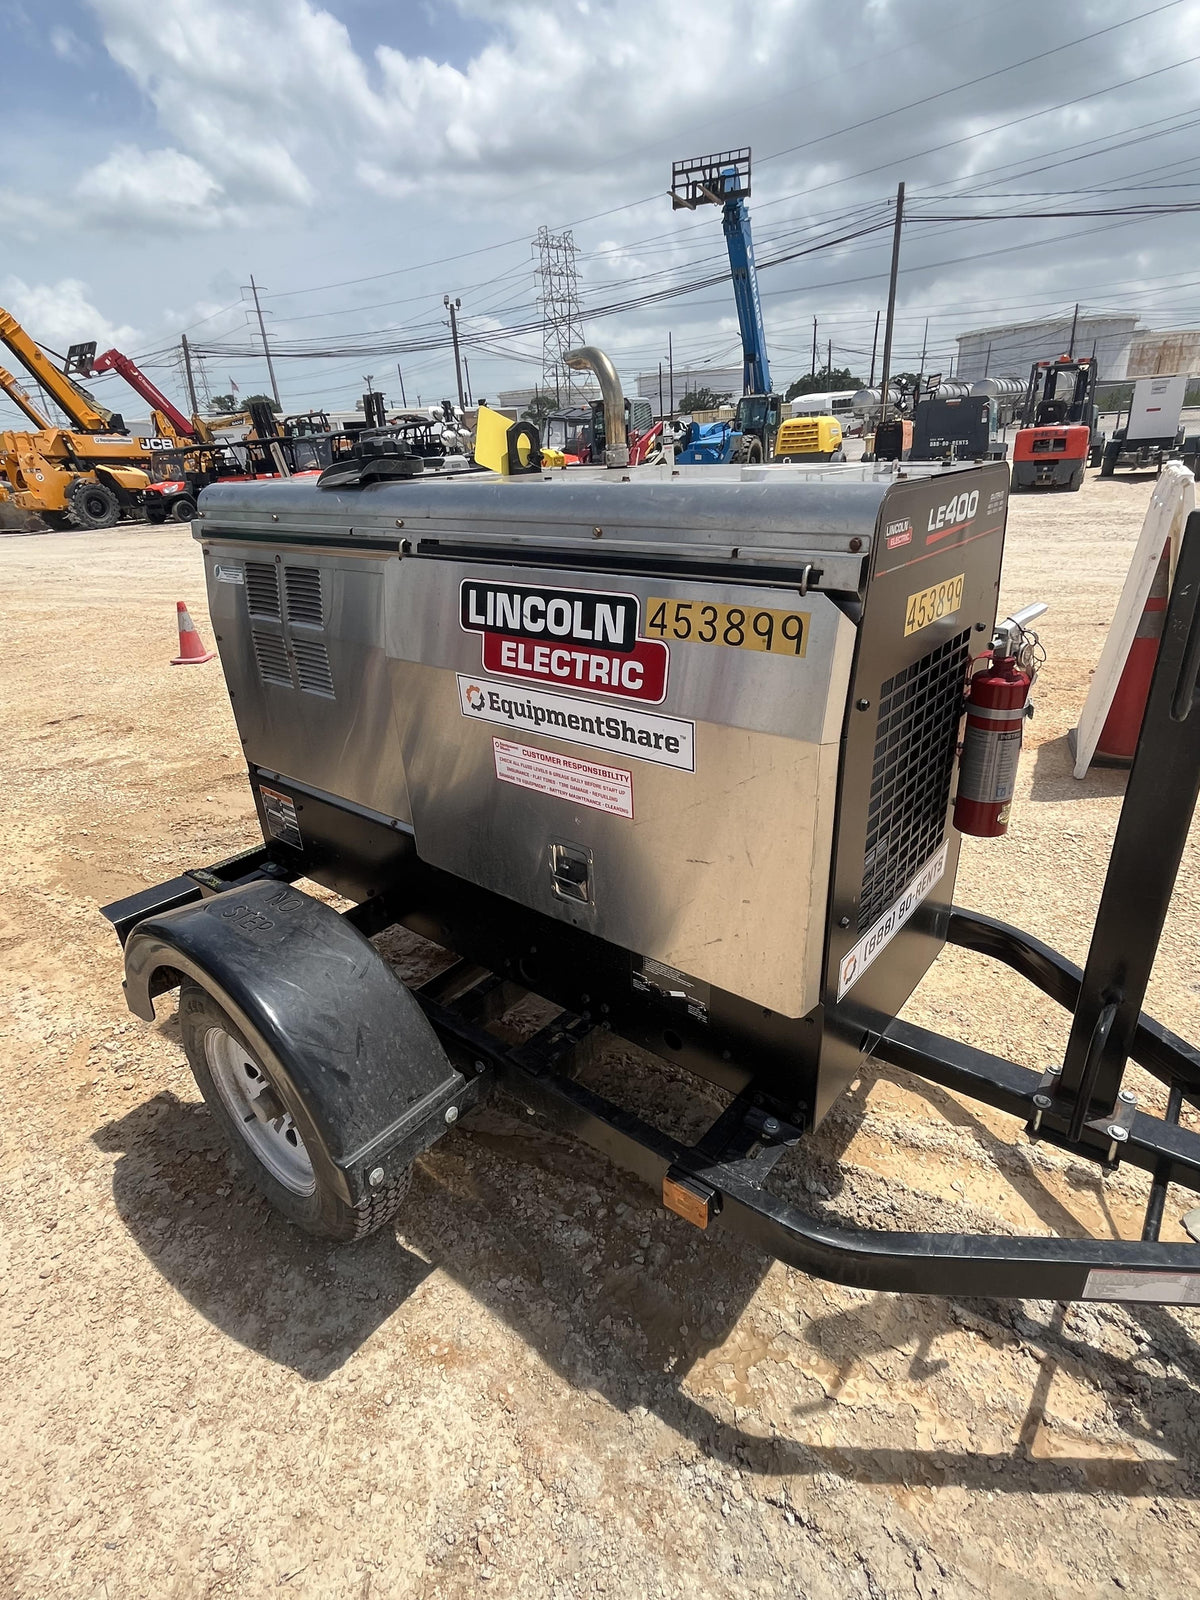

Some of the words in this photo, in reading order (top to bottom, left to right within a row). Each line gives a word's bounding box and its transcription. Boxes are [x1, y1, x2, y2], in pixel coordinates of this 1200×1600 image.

[141, 438, 174, 450] JCB
[886, 521, 909, 536] LINCOLN
[927, 489, 980, 532] LE400
[890, 533, 910, 546] ELECTRIC
[468, 588, 626, 645] LINCOLN
[906, 577, 963, 631] 453899
[649, 601, 804, 655] 453899
[501, 640, 644, 690] ELECTRIC
[487, 691, 680, 754] EquipmentShare
[522, 749, 562, 766] CUSTOMER
[562, 759, 629, 783] RESPONSIBILITY
[584, 780, 602, 789] BEFORE
[602, 785, 618, 794] START
[221, 905, 275, 933] STEP
[264, 889, 304, 912] NO
[863, 911, 896, 961] (888)
[898, 855, 944, 920] 80-RENTS
